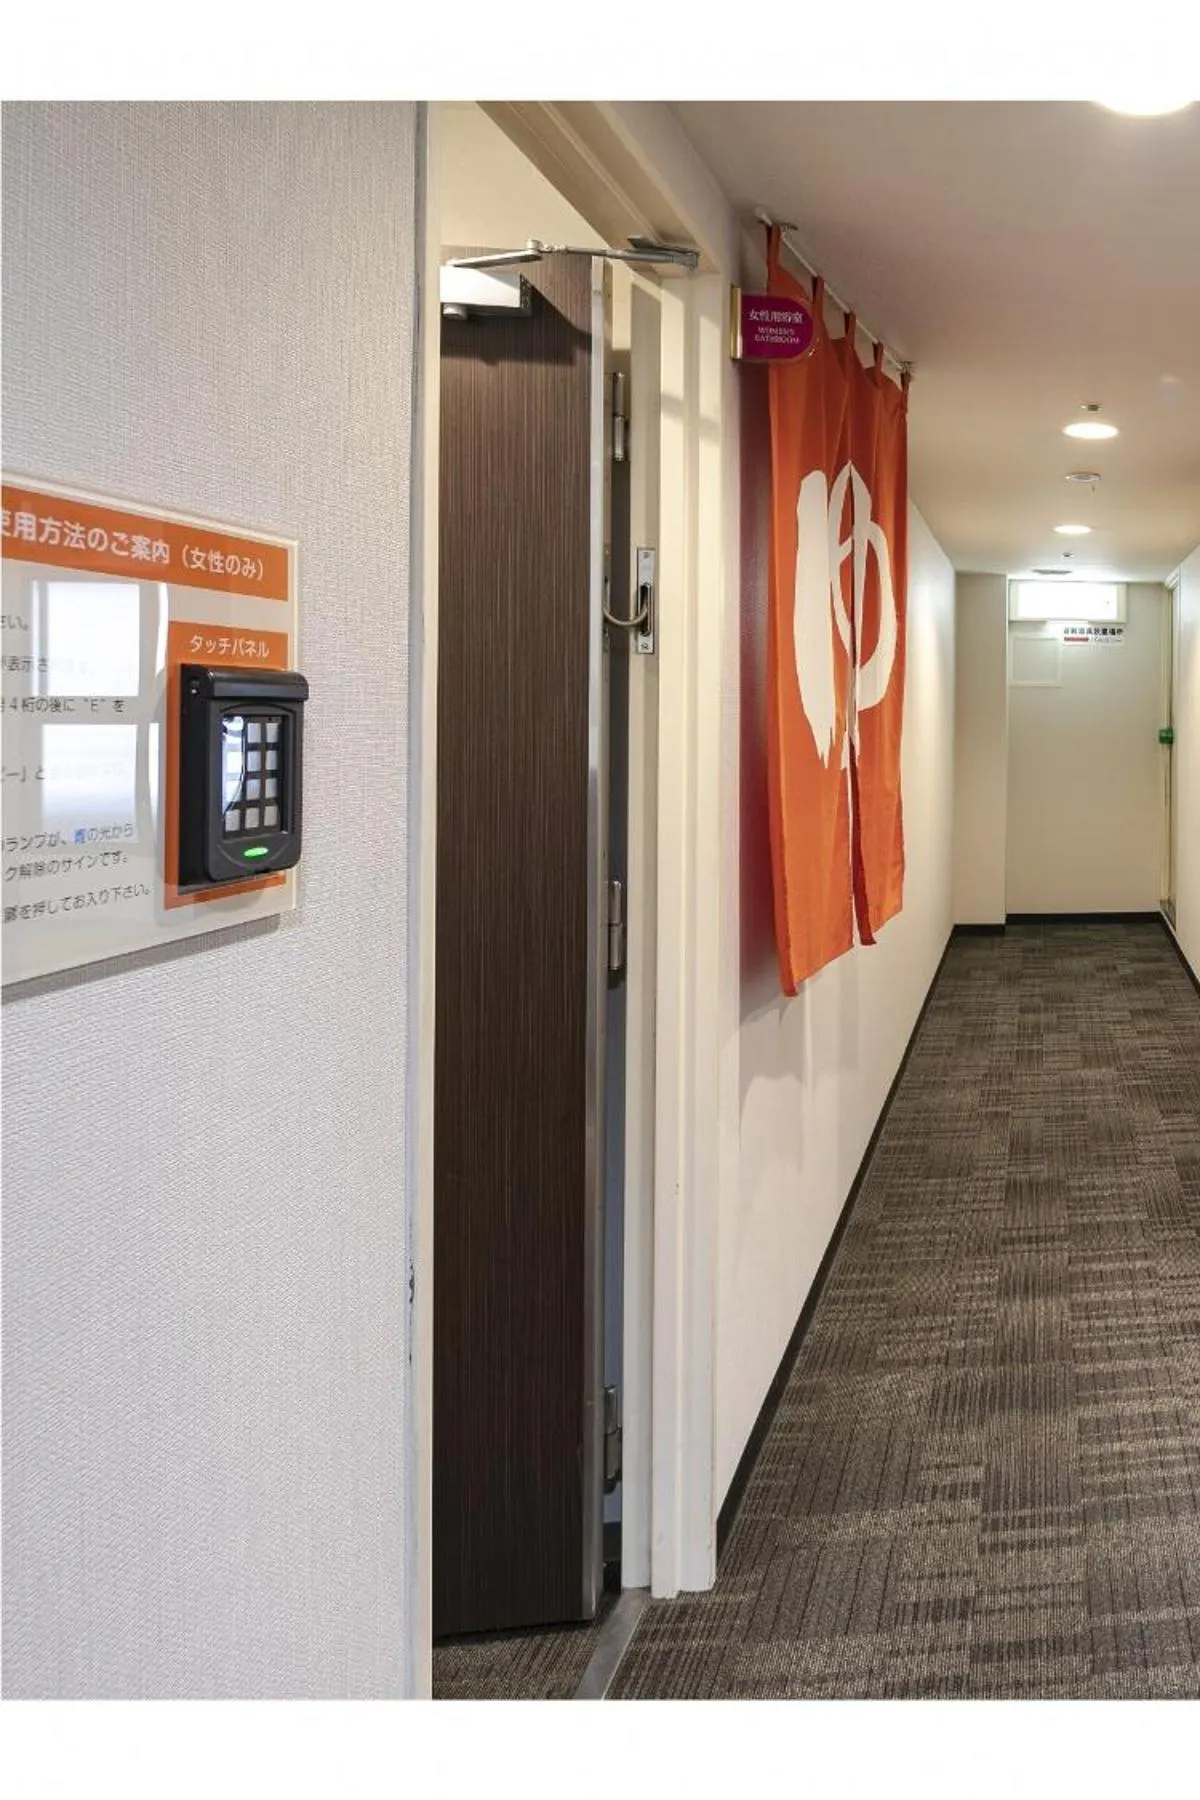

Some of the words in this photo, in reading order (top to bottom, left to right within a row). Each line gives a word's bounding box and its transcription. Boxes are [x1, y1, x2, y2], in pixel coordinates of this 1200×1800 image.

[190, 634, 270, 658] タッチパネル
